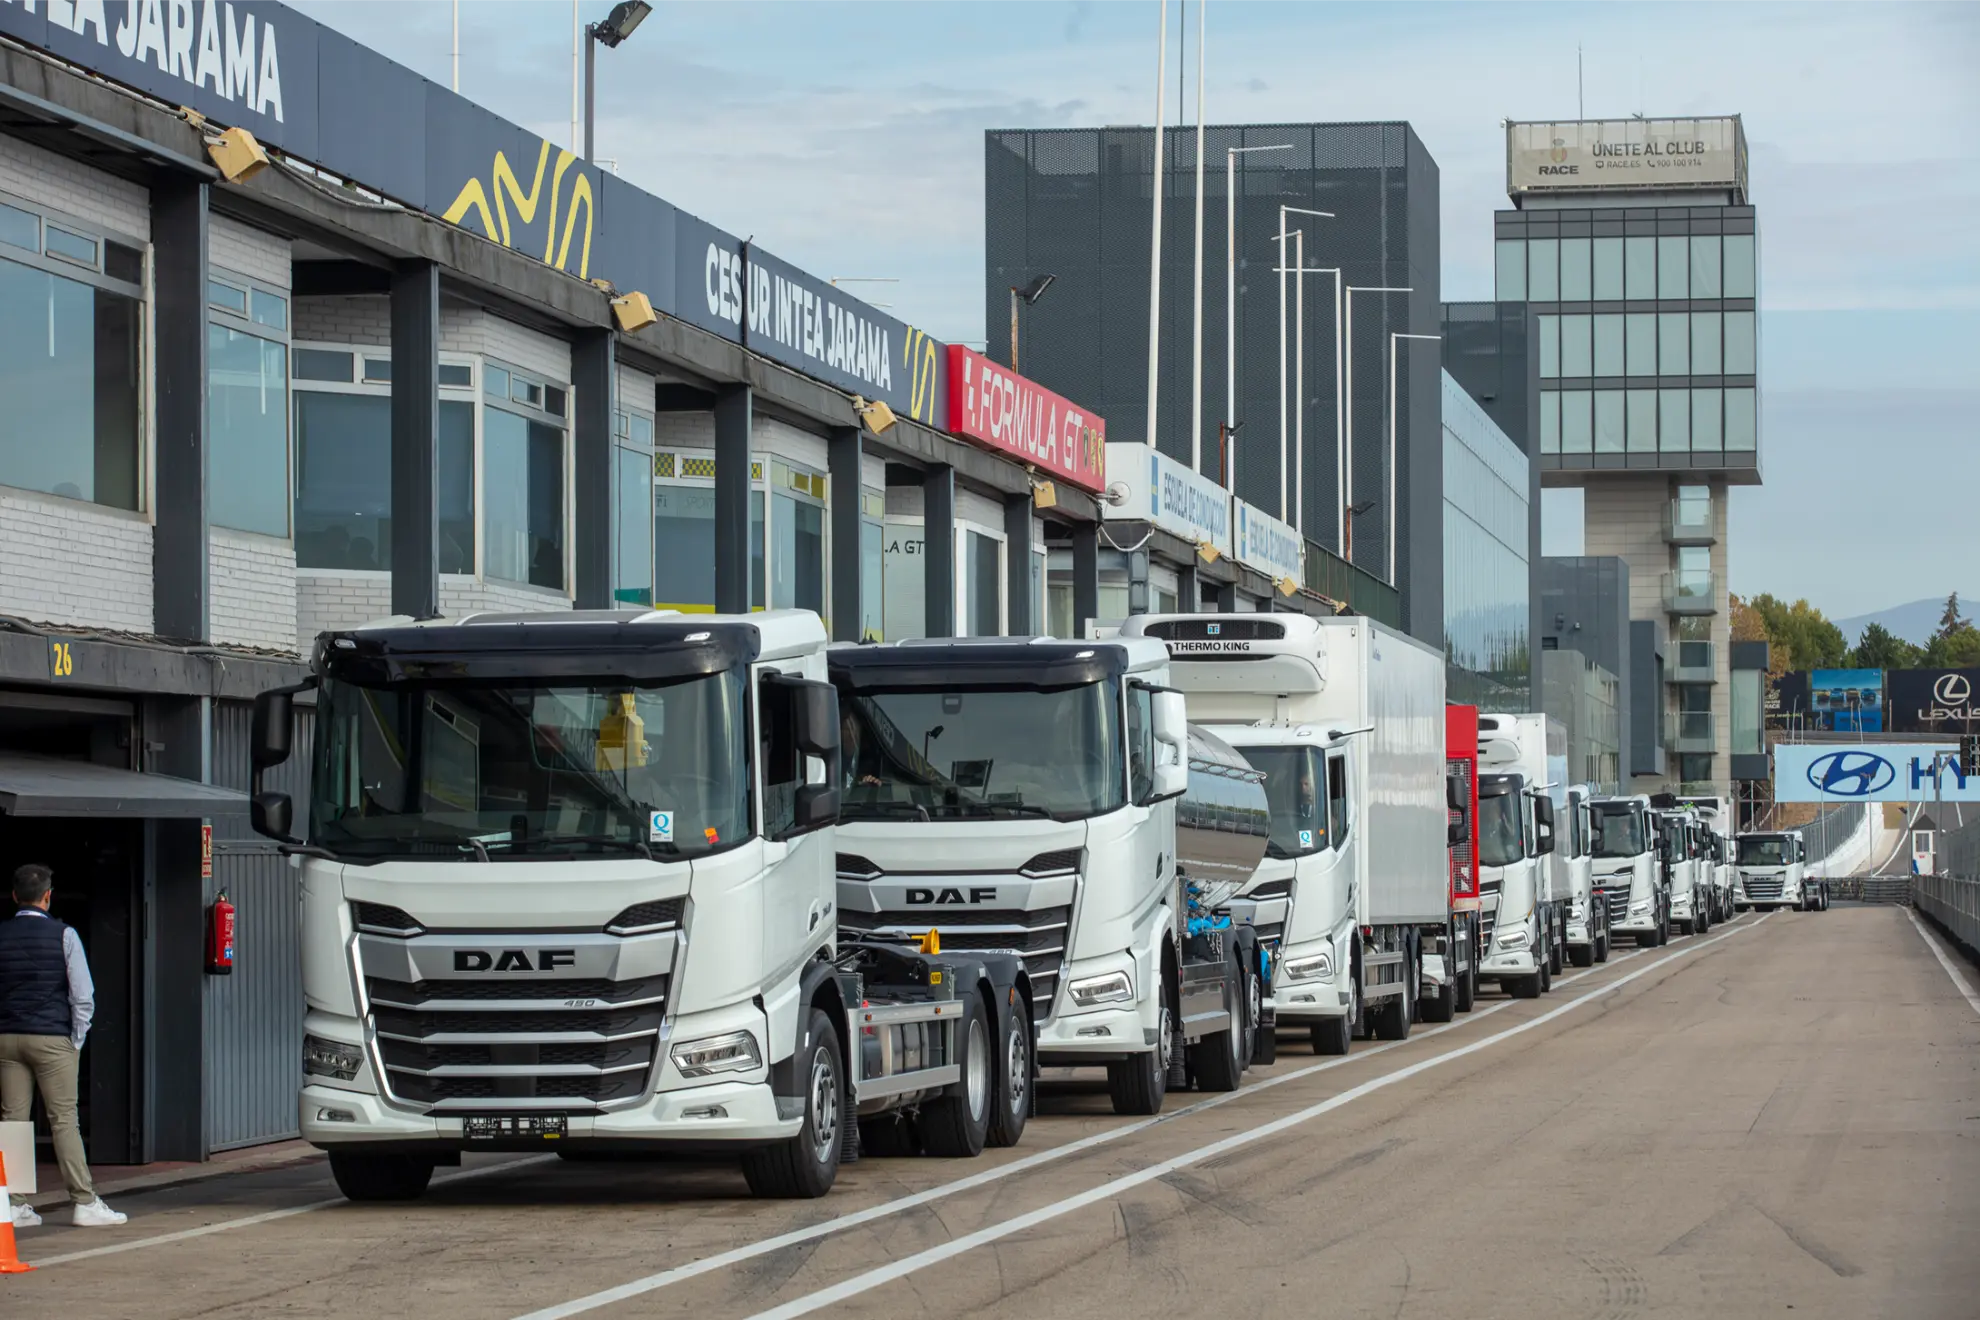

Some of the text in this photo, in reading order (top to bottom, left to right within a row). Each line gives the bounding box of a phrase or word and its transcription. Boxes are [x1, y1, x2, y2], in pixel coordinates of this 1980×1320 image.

[1643, 142, 1663, 156] AL
[1666, 141, 1705, 155] CLUB
[1538, 165, 1579, 176] RACE
[775, 275, 825, 363] INTEA
[827, 302, 892, 392] JARAMA
[979, 366, 1083, 473] FORMULA GT
[1174, 642, 1250, 651] THERMO KING
[53, 643, 73, 676] 26
[653, 814, 670, 834] Q
[905, 887, 997, 905] DAF
[453, 949, 576, 973] DAF
[563, 999, 596, 1008] 450
